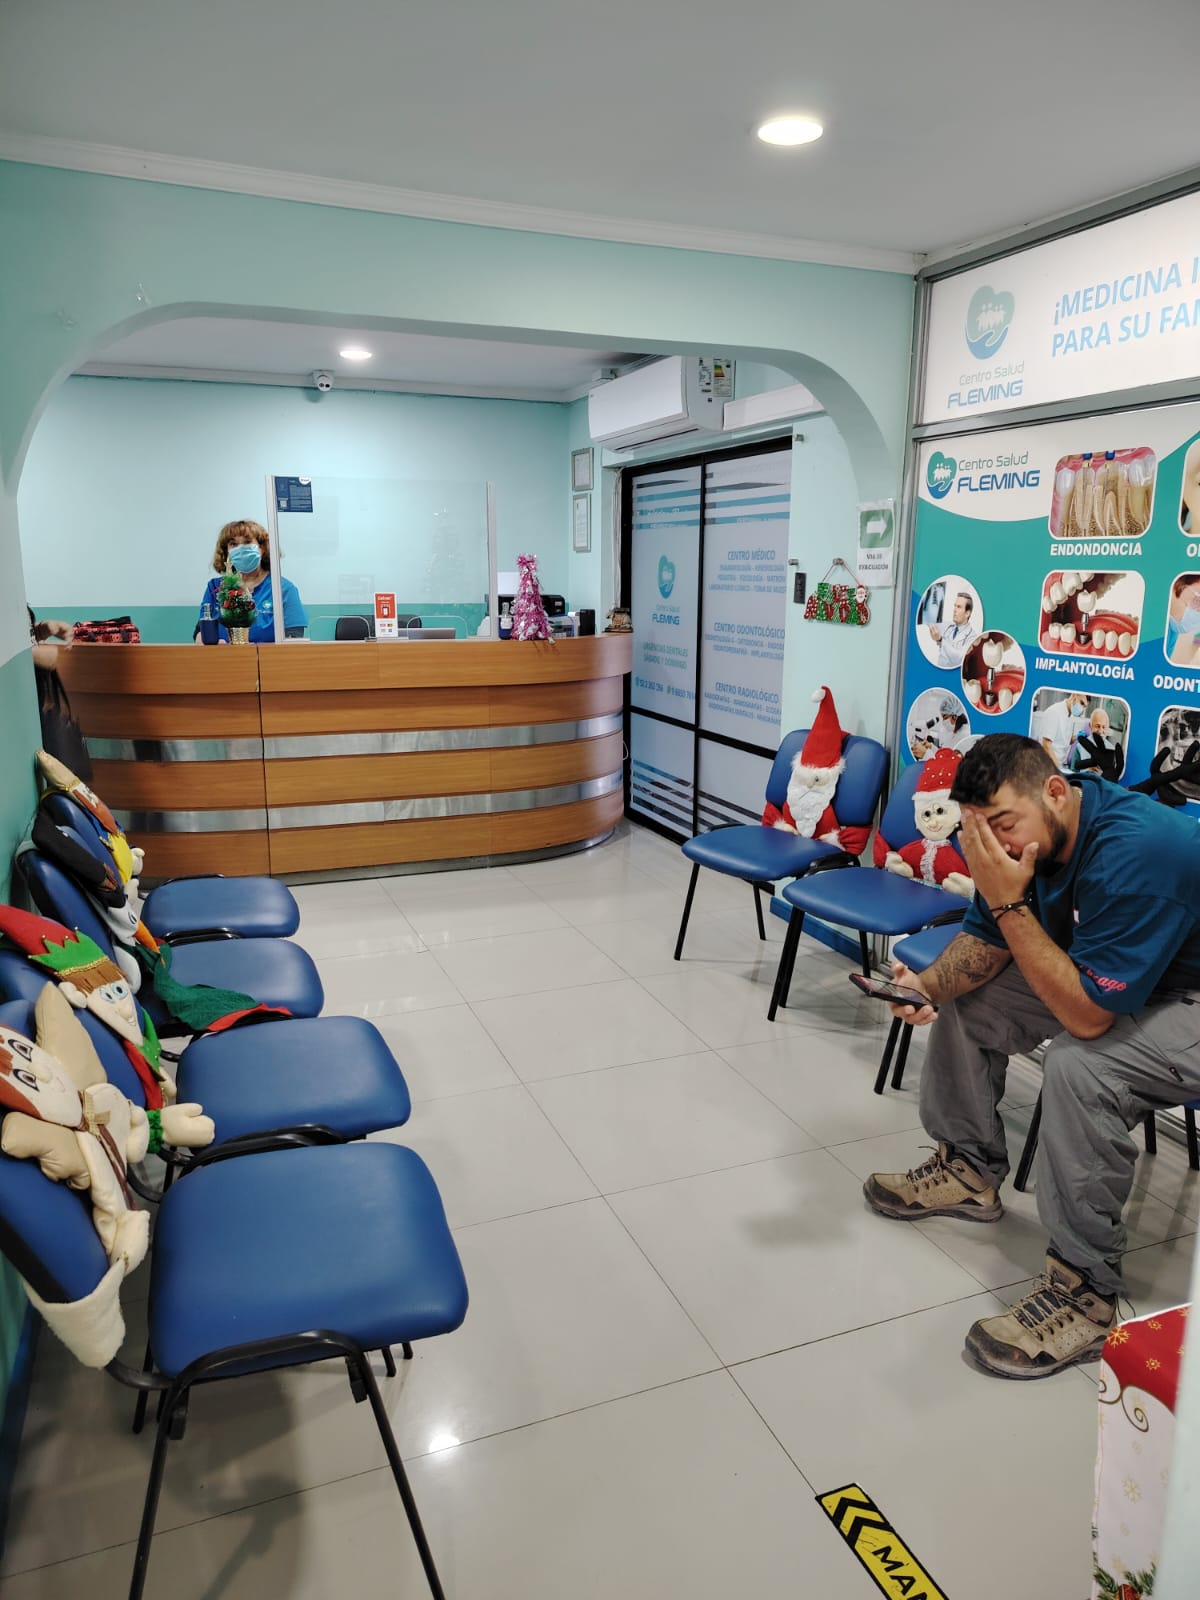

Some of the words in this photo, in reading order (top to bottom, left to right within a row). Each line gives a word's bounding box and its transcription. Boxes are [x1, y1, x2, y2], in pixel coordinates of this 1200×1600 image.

[1054, 262, 1182, 326] ¡MEDICINA
[1052, 322, 1112, 358] PARA
[1118, 311, 1151, 342] SU
[959, 365, 992, 386] Centro
[994, 360, 1024, 377] Salud
[947, 379, 1023, 409] FLEMING
[958, 456, 993, 471] Centro
[996, 451, 1029, 468] Salud
[957, 470, 1041, 493] FLEMING
[728, 550, 750, 560] CENTRO
[1050, 542, 1143, 556] ENDONDONCIA
[652, 613, 680, 625] FLEMING
[714, 622, 735, 634] CENTRO
[1035, 657, 1135, 680] IMPLANTOLOGÍA
[715, 681, 737, 695] CENTRO
